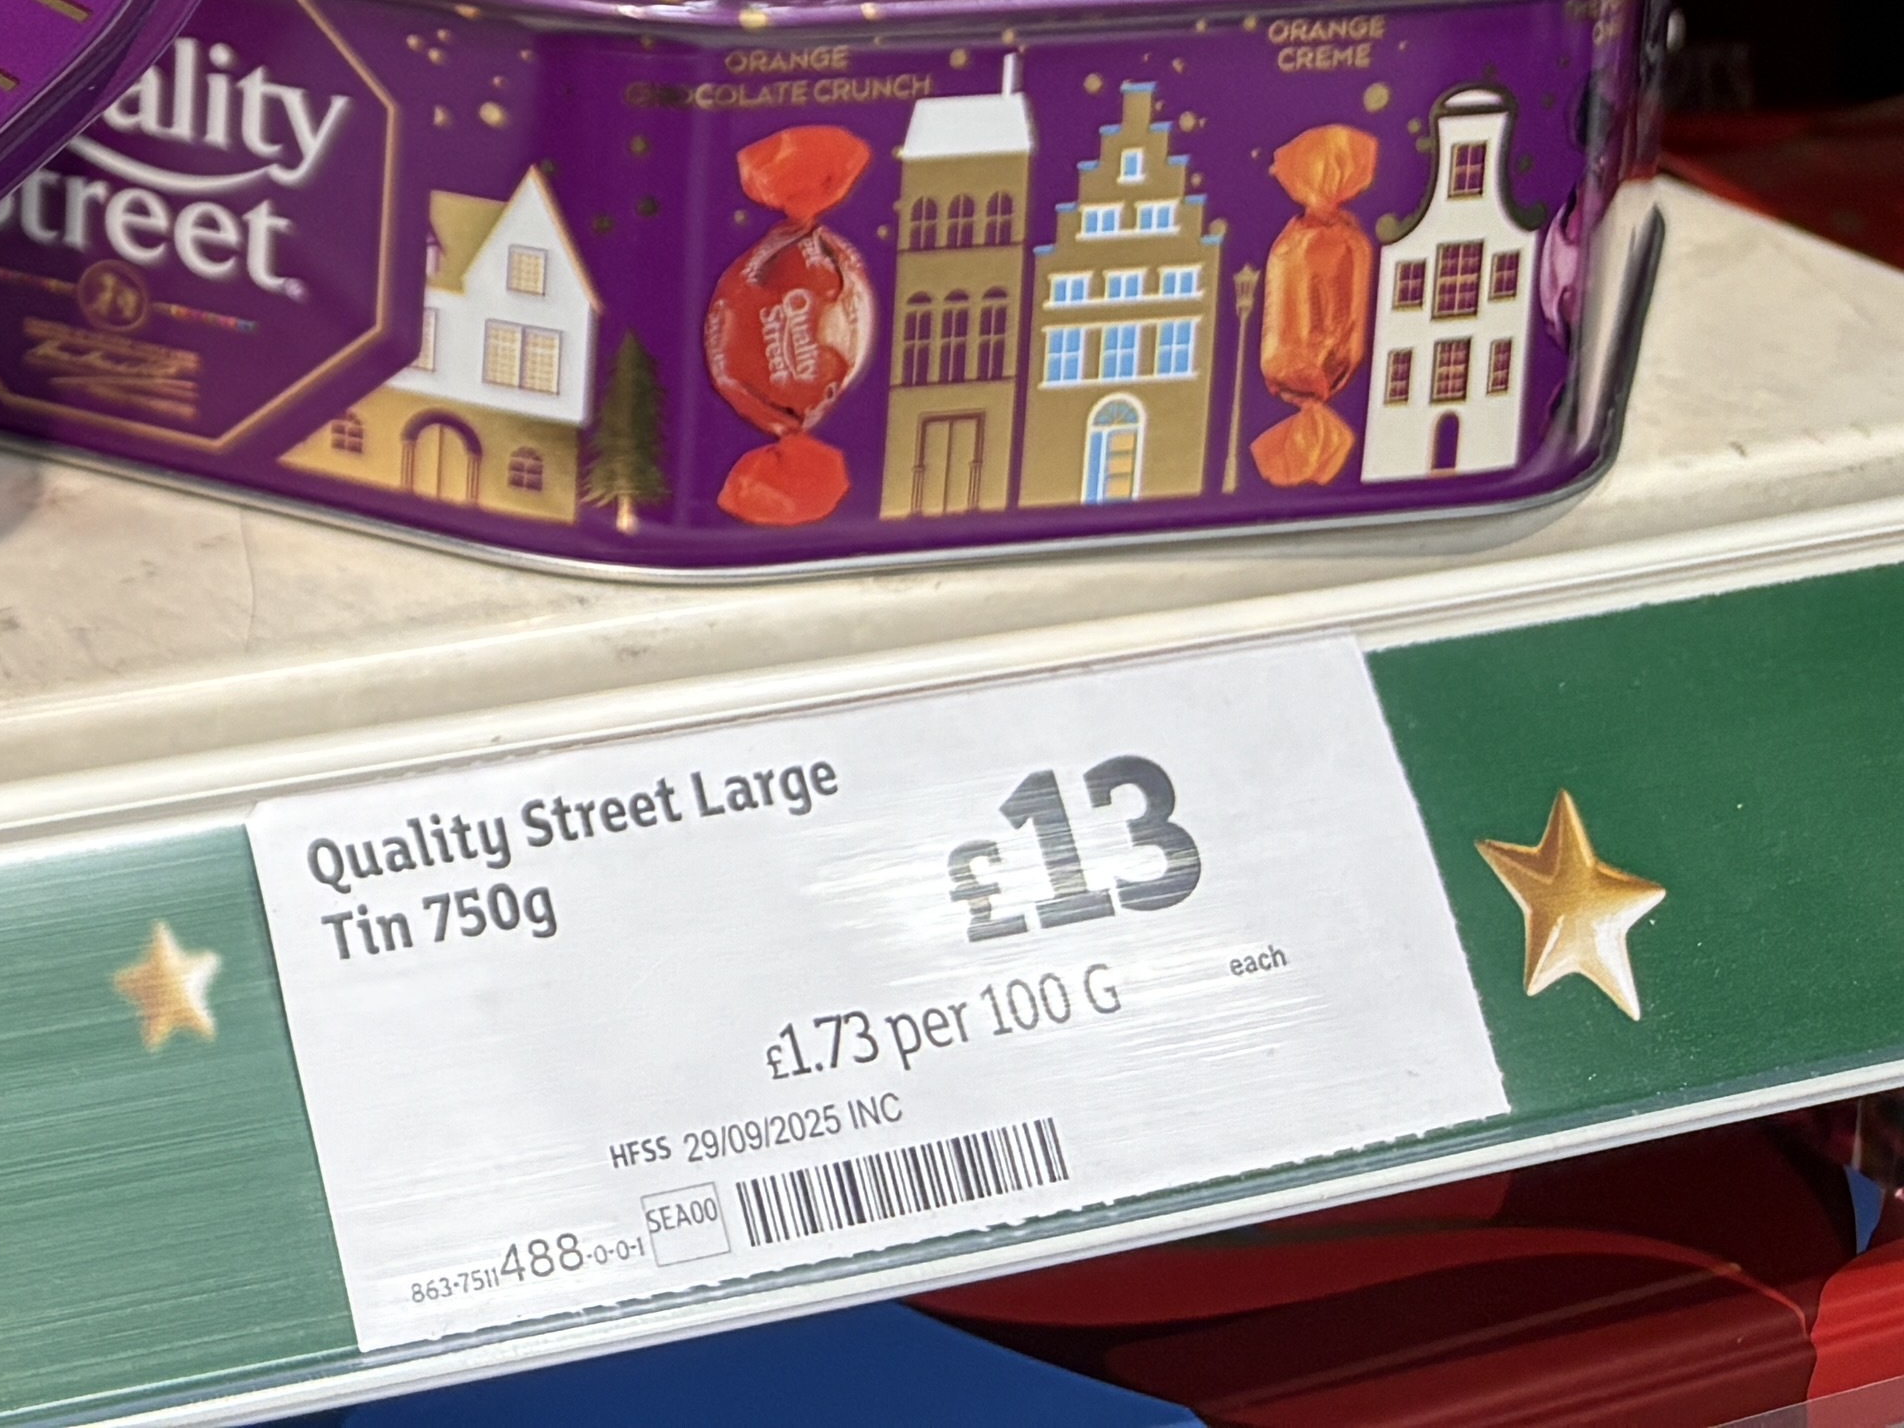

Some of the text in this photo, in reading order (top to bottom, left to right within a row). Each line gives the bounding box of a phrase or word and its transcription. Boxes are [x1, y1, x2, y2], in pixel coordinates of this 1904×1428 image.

[724, 45, 850, 75] ORANGE
[1268, 15, 1386, 44] ORANGE
[1276, 42, 1373, 73] CREME
[70, 36, 352, 186] ality
[624, 73, 934, 111] CCOLATE CRUNCH
[759, 304, 789, 386] Street
[782, 288, 819, 382] Quality
[306, 759, 840, 894] Quality Street Large
[947, 753, 1202, 943] £13
[321, 882, 558, 961] Tin 750g
[1228, 944, 1289, 977] each
[766, 962, 1123, 1081] £1.73 per 100 G
[608, 1091, 905, 1169] HFSS 29/09/2025 INC
